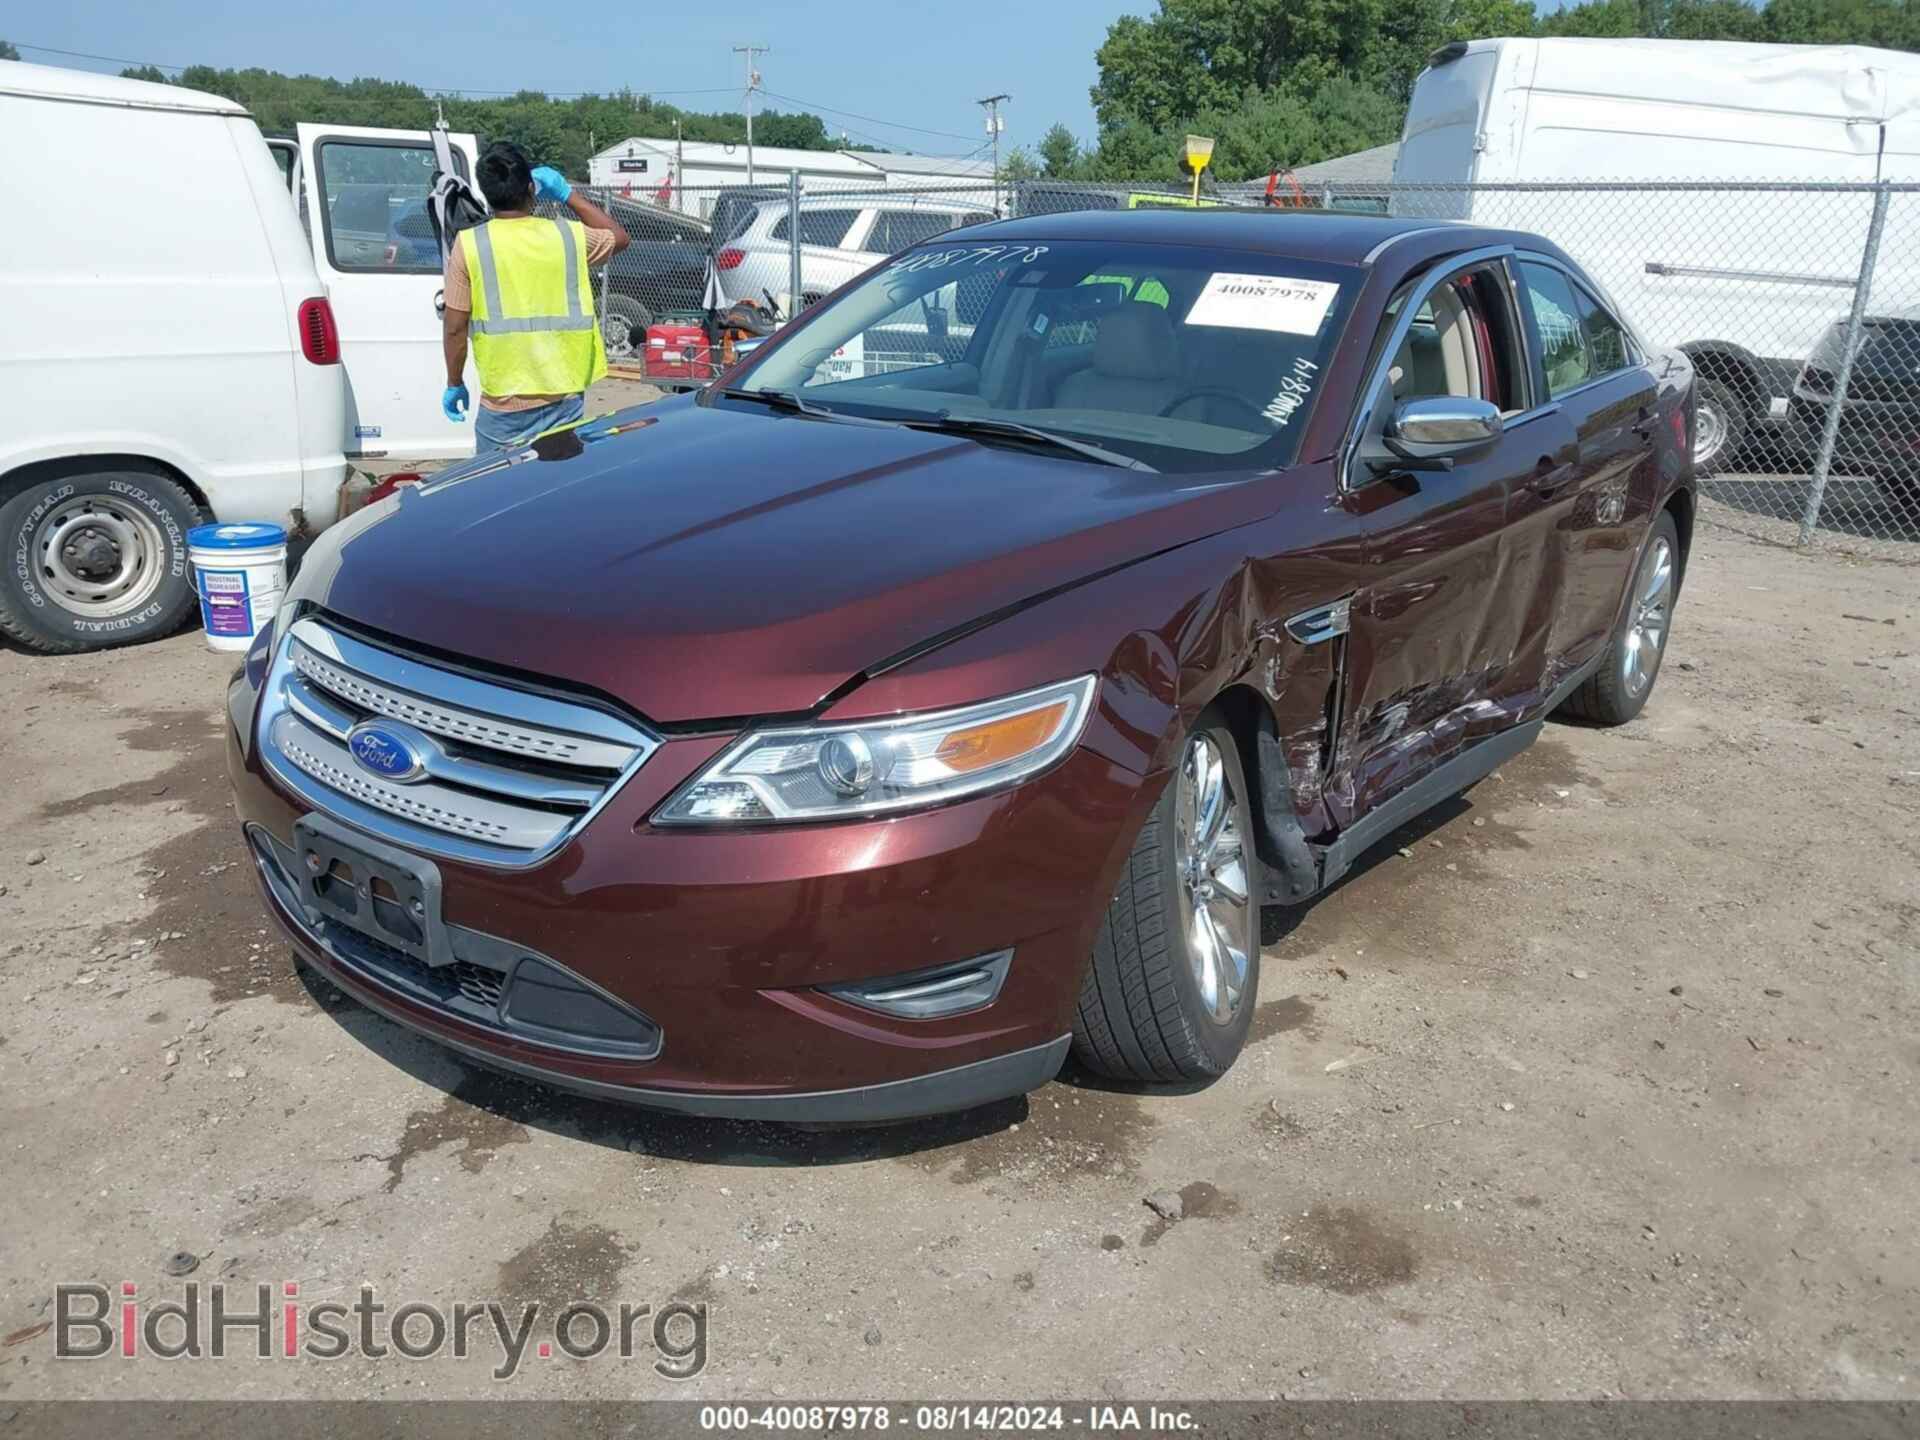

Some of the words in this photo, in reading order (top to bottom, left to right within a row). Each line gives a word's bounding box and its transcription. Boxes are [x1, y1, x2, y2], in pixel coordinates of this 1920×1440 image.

[1217, 283, 1318, 301] 40087978
[16, 484, 75, 607] GOODYEAR
[108, 480, 184, 577] WRANGLER
[73, 601, 162, 632] RADIAL
[359, 735, 398, 769] Ford
